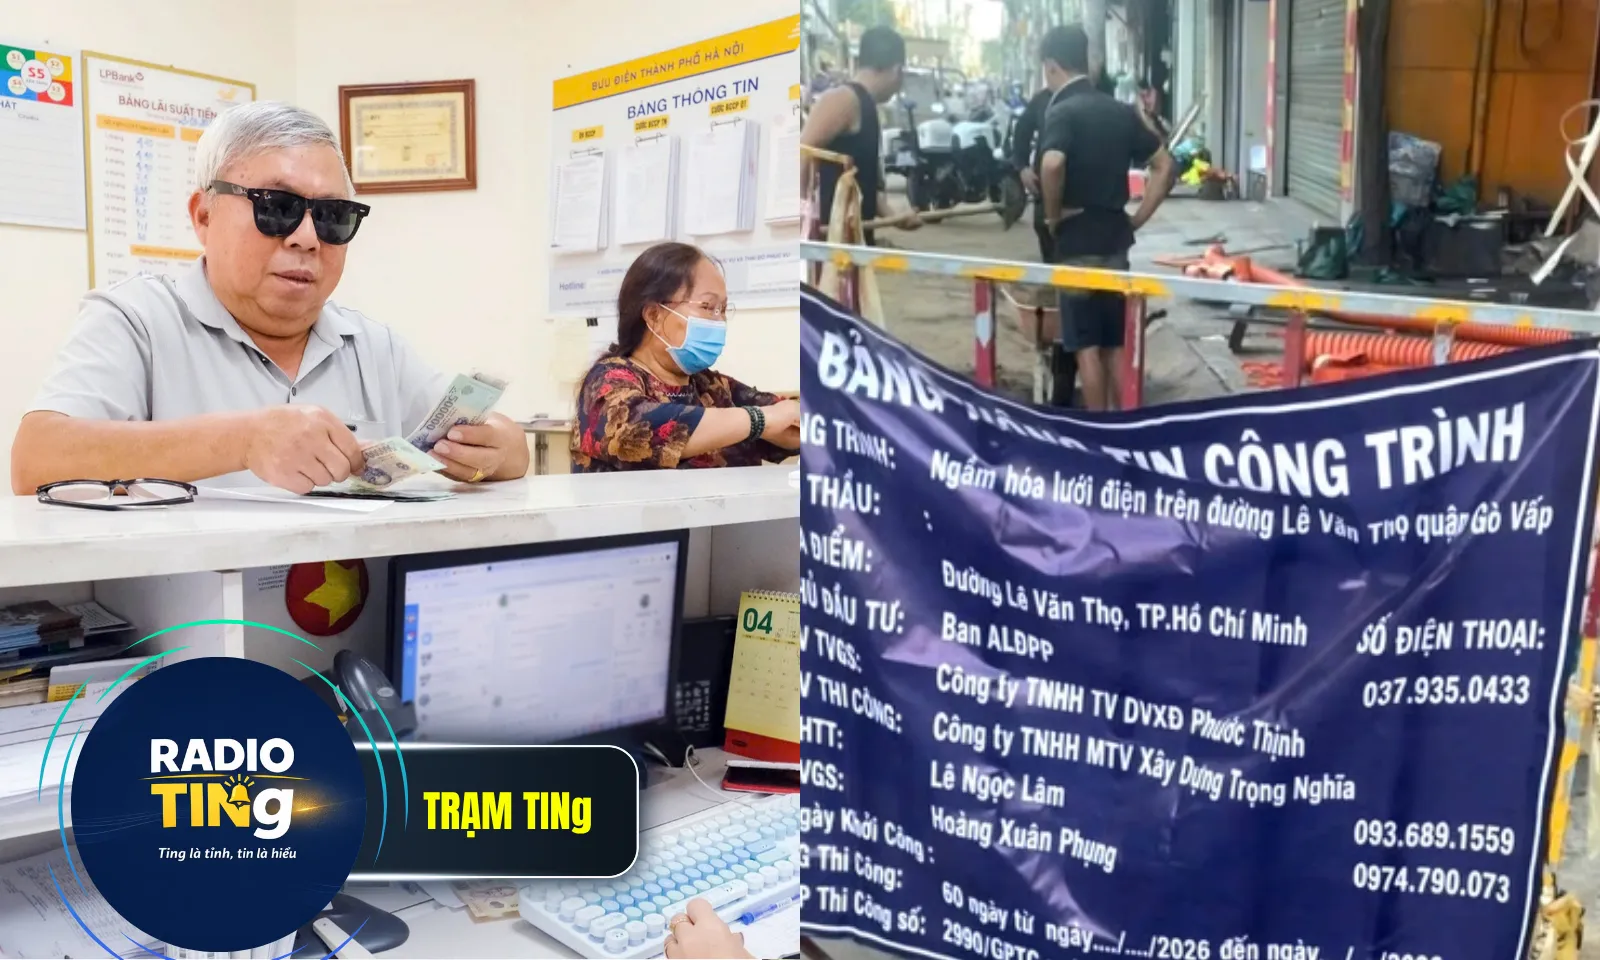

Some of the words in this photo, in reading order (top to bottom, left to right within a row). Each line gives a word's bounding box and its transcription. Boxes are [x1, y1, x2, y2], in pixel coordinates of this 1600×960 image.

[28, 67, 45, 79] S5
[99, 69, 135, 83] LPBank
[591, 78, 611, 91] BƯU
[614, 69, 637, 85] ĐIỆN
[640, 61, 675, 78] THÀNH
[678, 49, 701, 69] PHỐ
[704, 46, 719, 62] HÀ
[724, 42, 745, 57] NỘI
[118, 93, 150, 109] BẢNG
[151, 99, 168, 113] LÃI
[169, 103, 195, 116] SUẤT
[627, 98, 667, 119] BẢNG
[672, 84, 727, 109] THÔNG
[732, 76, 760, 95] TIN
[818, 328, 944, 413] BẢNG
[1203, 428, 1349, 497] CÔNG
[1365, 402, 1525, 490] TRÌNH
[806, 469, 880, 516] THẦU:
[931, 449, 996, 491] Ngầm
[1005, 464, 1045, 498] hóa
[1054, 470, 1092, 507] lưới
[1101, 479, 1147, 519] điện
[1156, 488, 1199, 523] trên
[1207, 495, 1273, 540] đường
[1282, 505, 1310, 535] Lê
[1319, 508, 1360, 544] Văn
[1470, 501, 1502, 535] Gò
[1511, 495, 1554, 535] Vấp
[810, 523, 873, 573] ĐIỂM:
[941, 560, 1002, 607] Đường
[1006, 580, 1028, 611] Lê
[1033, 588, 1074, 622] Văn
[1081, 596, 1130, 632] Thọ,
[1136, 602, 1201, 633] TP.Hồ
[1209, 606, 1246, 639] Chí
[1252, 612, 1308, 646] Minh
[743, 608, 773, 635] 04
[821, 582, 856, 626] ĐẦU
[865, 598, 905, 634] TƯ:
[941, 611, 981, 646] Ban
[987, 624, 1054, 662] ALĐPP
[1356, 611, 1393, 656] SỐ
[1395, 617, 1453, 657] ĐIỆN
[1462, 619, 1545, 656] THOẠI:
[814, 629, 863, 673] TVGS:
[936, 663, 990, 704] Công
[998, 673, 1020, 708] ty
[1025, 676, 1085, 714] TNHH
[1091, 689, 1119, 720] TV
[1124, 699, 1184, 731] DVXĐ
[1190, 707, 1246, 747] Phước
[1252, 719, 1306, 762] Thịnh
[1362, 675, 1530, 708] 037.935.0433
[816, 675, 850, 709] THI
[851, 686, 903, 734] CÔNG:
[933, 711, 987, 753] Công
[993, 723, 1015, 757] ty
[1020, 726, 1081, 762] TNHH
[1086, 737, 1134, 772] MTV
[1138, 747, 1176, 787] Xây
[1179, 756, 1224, 801] Dựng
[1229, 769, 1287, 808] Trọng
[1293, 774, 1356, 805] Nghĩa
[930, 760, 955, 790] Lê
[962, 765, 1016, 804] Ngọc
[1021, 774, 1066, 808] Lâm
[840, 807, 879, 842] Khởi
[884, 821, 925, 863] Công
[930, 805, 994, 849] Hoàng
[999, 817, 1053, 852] Xuân
[1059, 827, 1118, 873] Phụng
[1353, 819, 1516, 856] 093.689.1559
[817, 843, 850, 872] Thi
[853, 850, 903, 893] Công:
[941, 881, 964, 908] 60
[968, 896, 1009, 931] ngày
[1014, 908, 1035, 935] từ
[1218, 934, 1259, 960] đến
[1353, 862, 1510, 903] 0974.790.073
[816, 886, 849, 913] Thi
[853, 890, 893, 932] Công
[897, 905, 926, 936] số:
